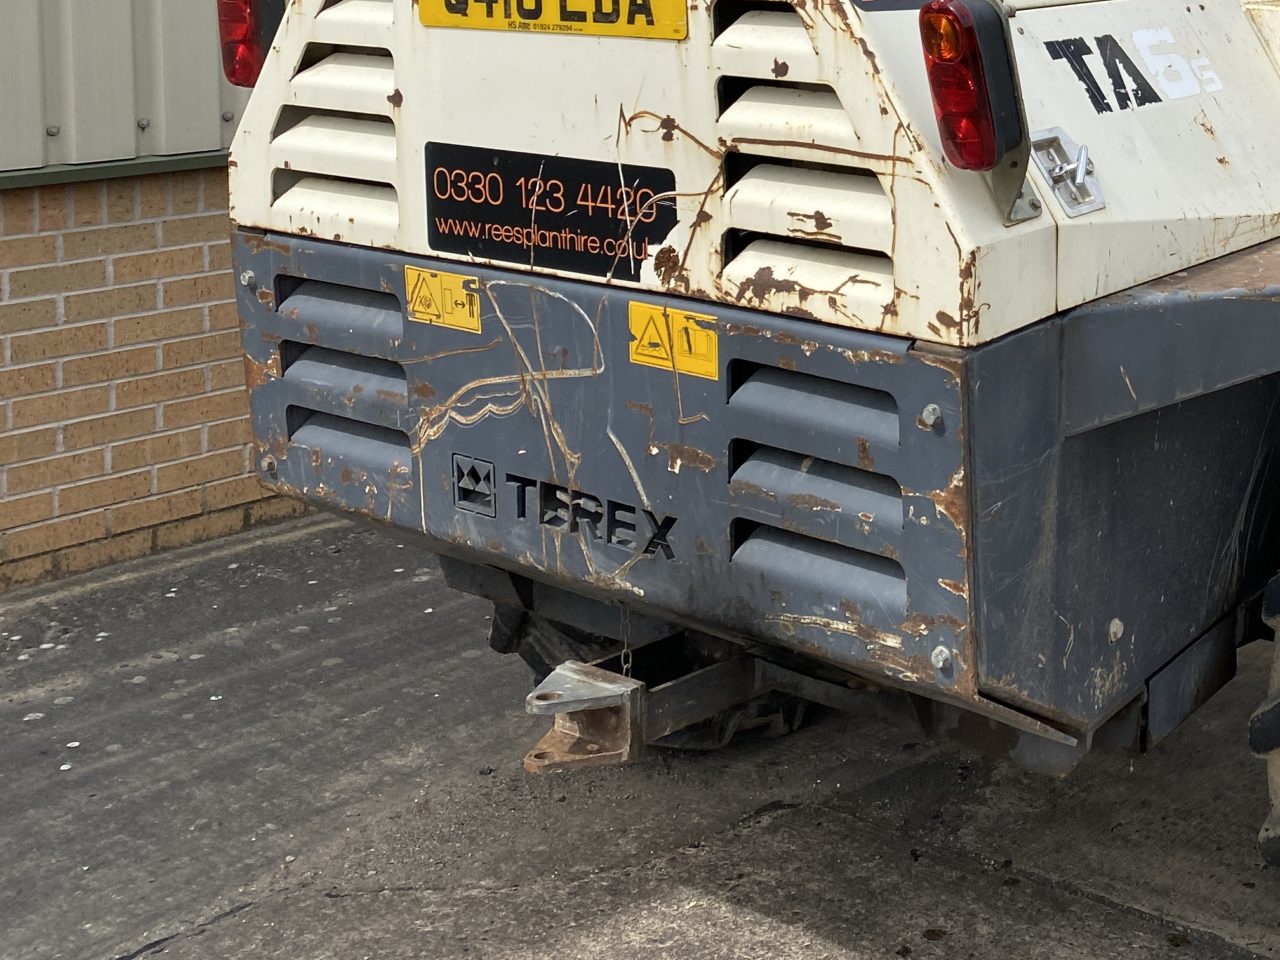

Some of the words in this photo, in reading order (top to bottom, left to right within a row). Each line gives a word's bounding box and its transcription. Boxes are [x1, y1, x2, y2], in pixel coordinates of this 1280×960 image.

[433, 166, 503, 206] 0330
[515, 177, 565, 213] 123
[576, 183, 657, 223] 4420
[435, 217, 649, 260] www.reesplanthire.cou
[505, 472, 677, 561] TEREX
